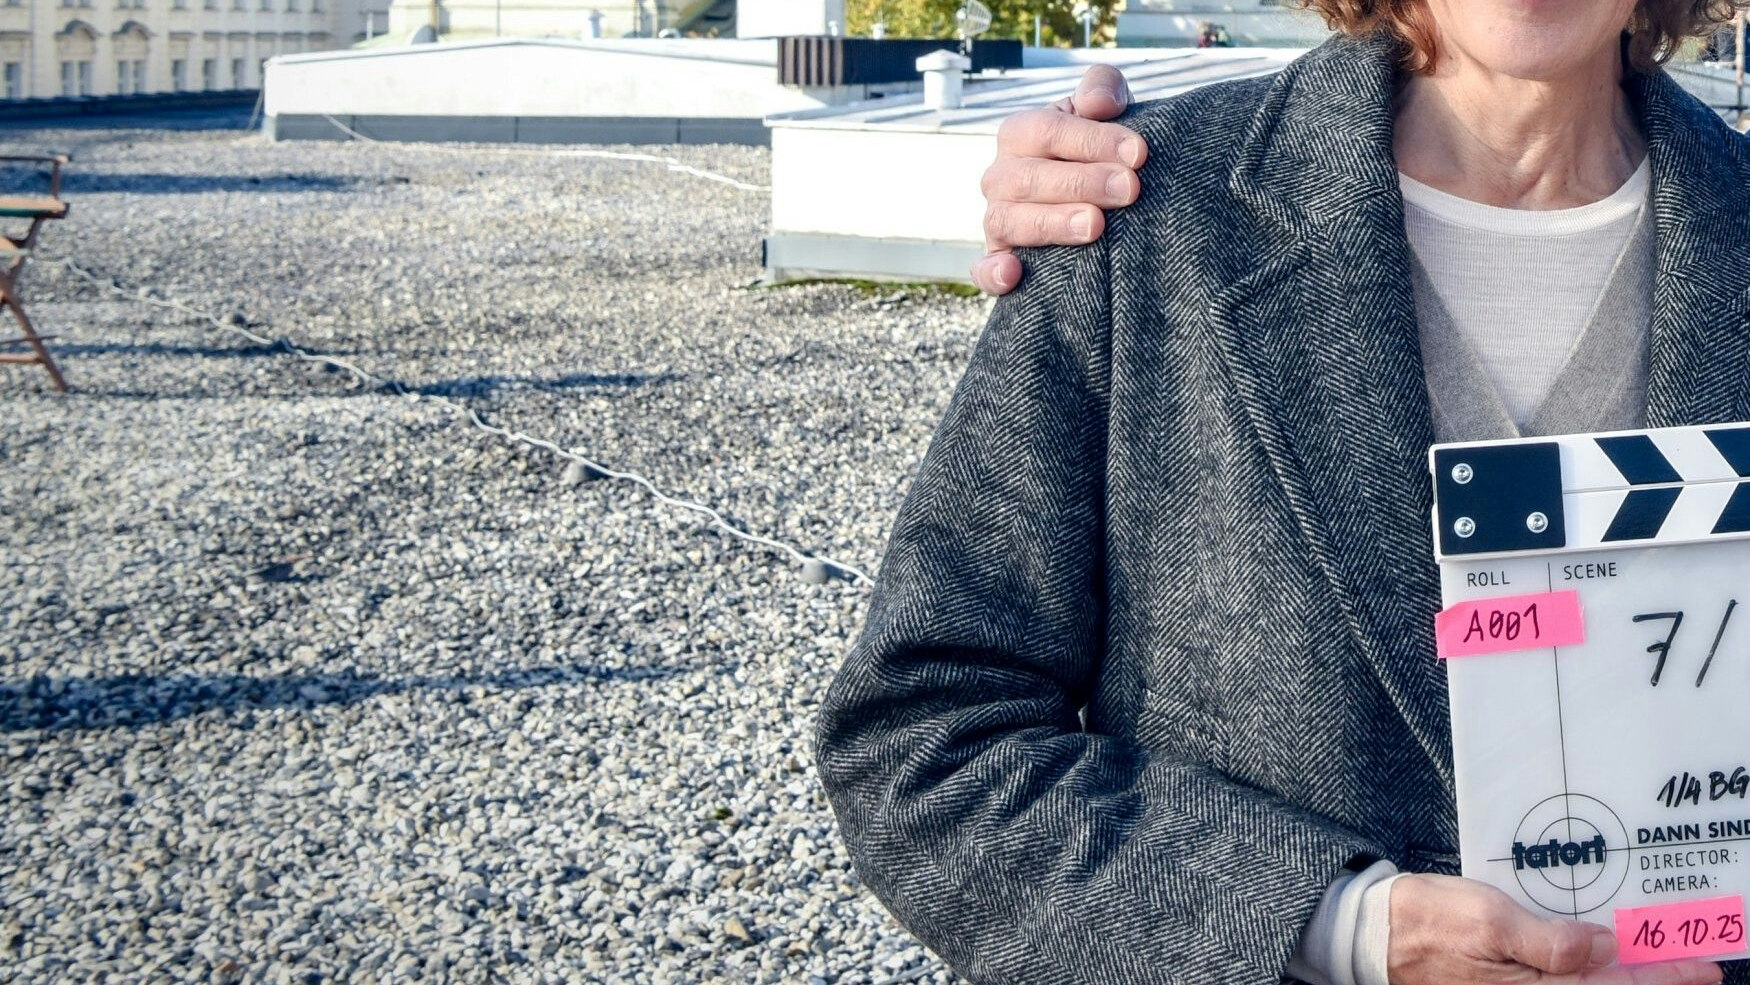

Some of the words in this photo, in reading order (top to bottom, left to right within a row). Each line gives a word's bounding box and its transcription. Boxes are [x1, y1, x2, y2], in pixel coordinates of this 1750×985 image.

[1467, 571, 1510, 587] ROLL
[1564, 562, 1617, 580] SCENE
[1708, 766, 1750, 802] BG
[1637, 823, 1700, 845] DANN
[1512, 835, 1607, 870] tatort
[1640, 848, 1739, 871] DIRECTOR:
[1642, 874, 1719, 894] CAMERA:
